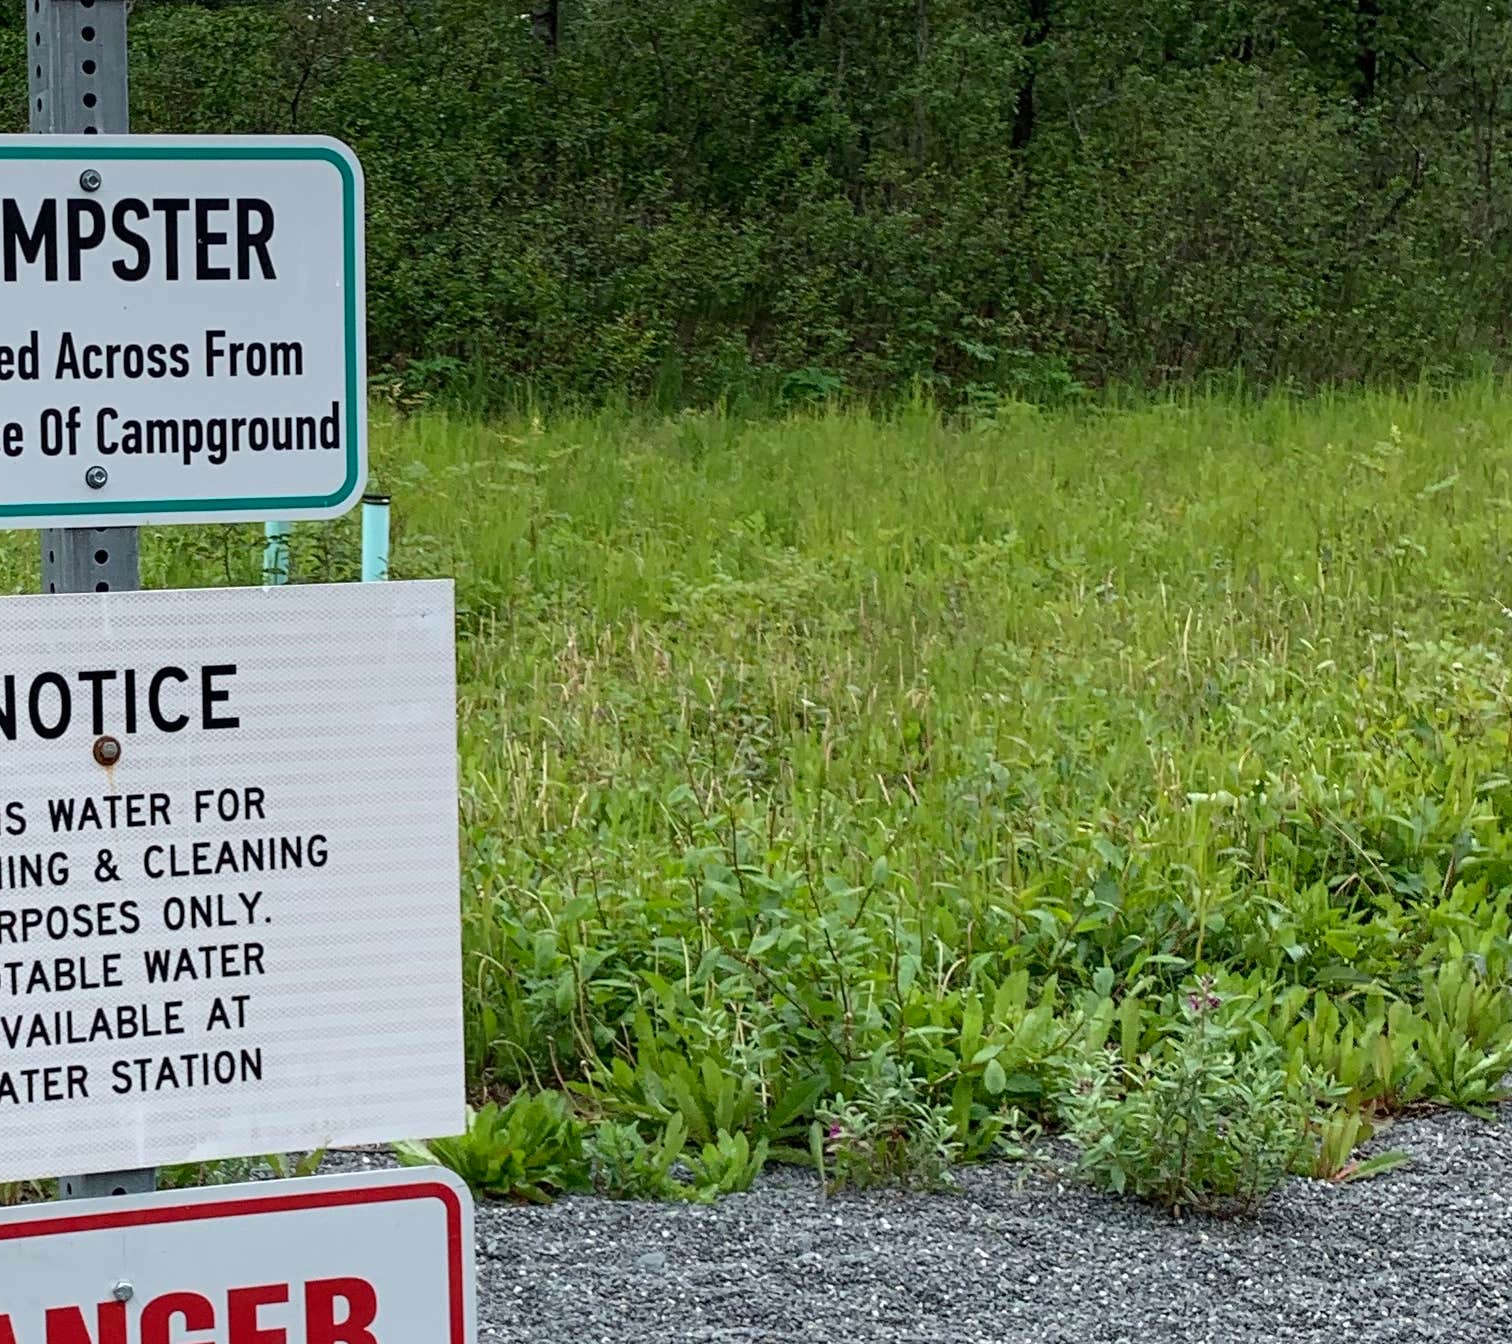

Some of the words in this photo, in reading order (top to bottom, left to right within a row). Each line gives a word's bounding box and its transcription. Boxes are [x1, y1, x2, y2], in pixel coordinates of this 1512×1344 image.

[55, 331, 190, 379] Across
[206, 330, 303, 377] From
[40, 406, 81, 456] Of
[96, 401, 341, 465] Campground
[48, 793, 171, 832] WATER
[194, 787, 266, 822] FOR
[94, 849, 120, 883] &
[144, 835, 329, 878] CLEANING
[163, 893, 271, 930] ONLY.
[144, 943, 265, 981] WATER
[205, 996, 251, 1031] AT
[111, 1048, 263, 1094] STATION
